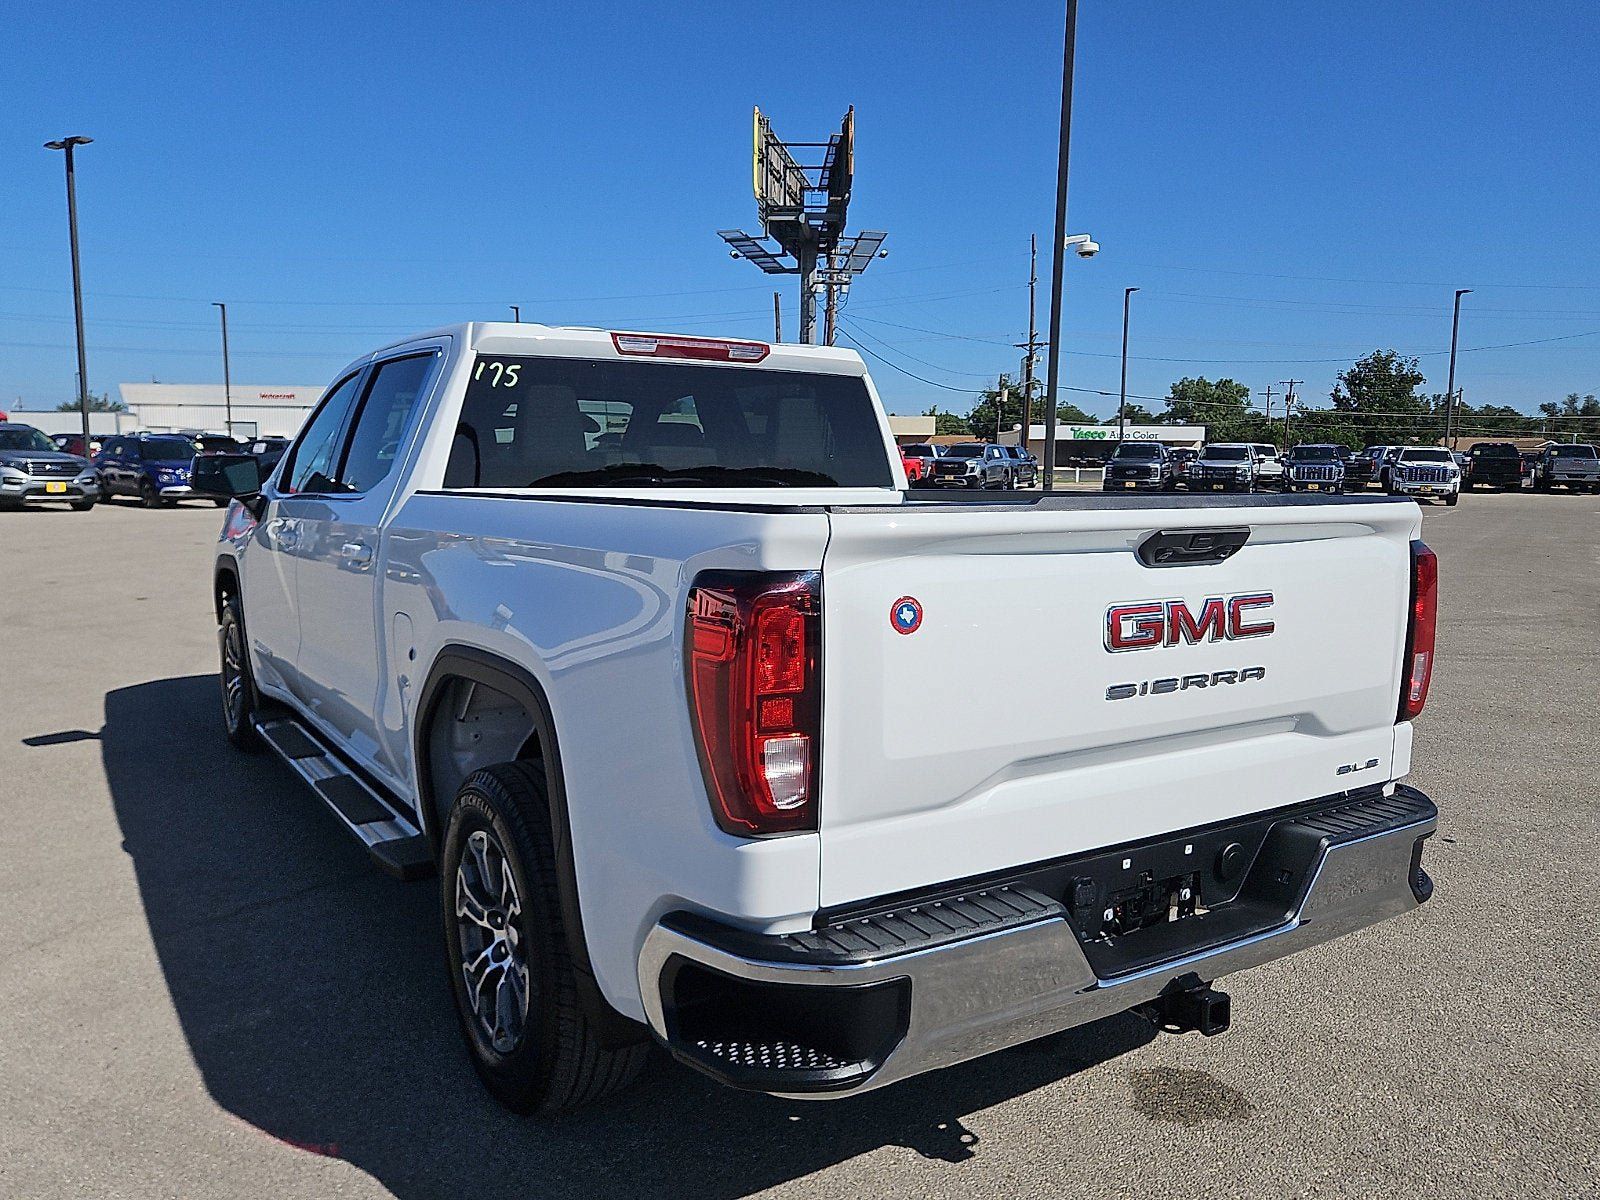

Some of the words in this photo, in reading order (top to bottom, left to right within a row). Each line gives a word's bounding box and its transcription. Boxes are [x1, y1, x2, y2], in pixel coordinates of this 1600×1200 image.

[475, 361, 522, 388] 175
[1132, 430, 1160, 440] Color
[1102, 590, 1276, 654] GMC
[1105, 666, 1267, 701] SIERRA
[1335, 757, 1380, 776] SLE
